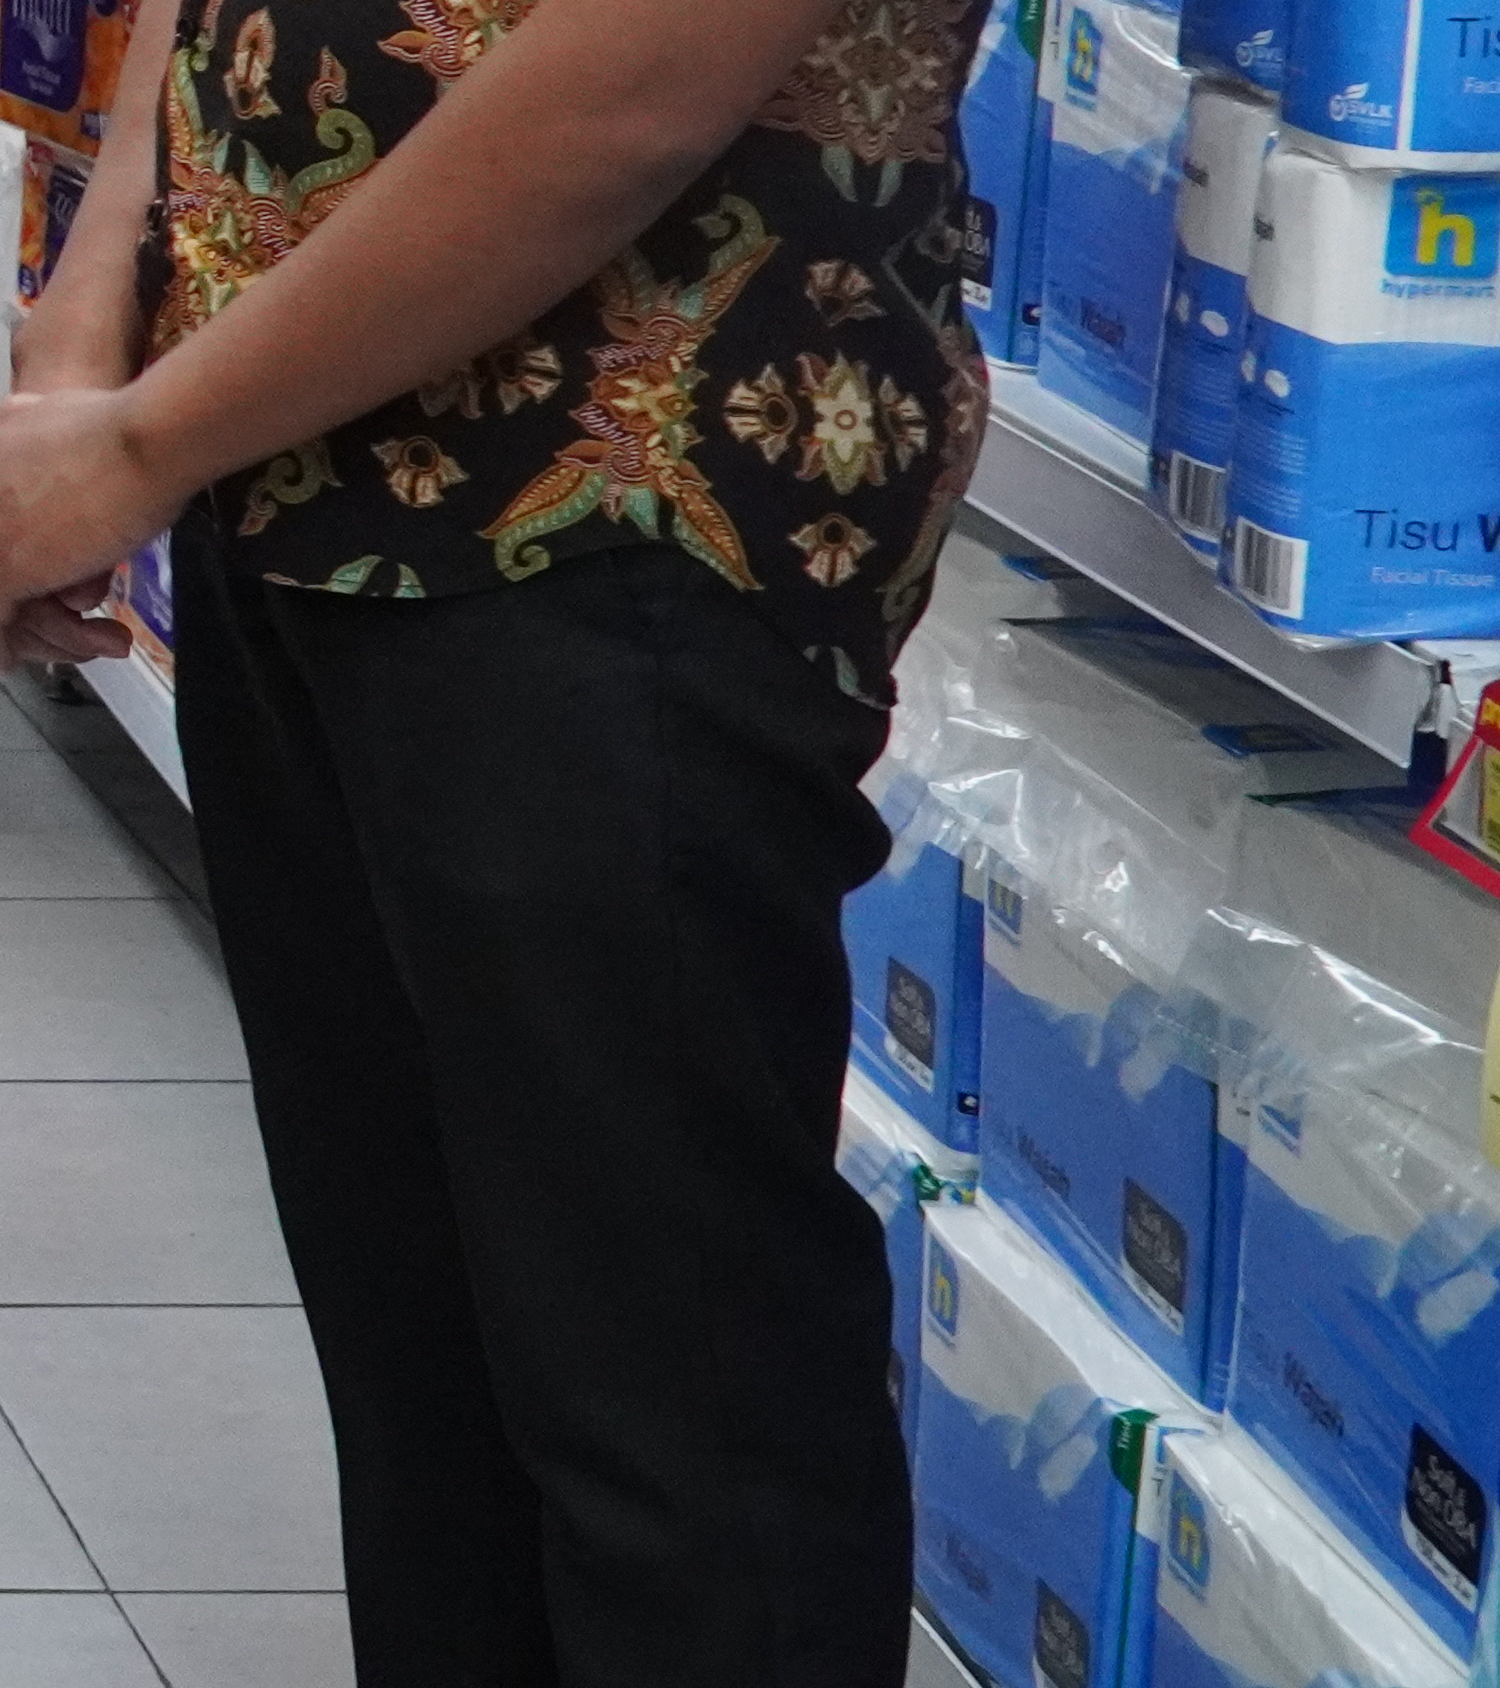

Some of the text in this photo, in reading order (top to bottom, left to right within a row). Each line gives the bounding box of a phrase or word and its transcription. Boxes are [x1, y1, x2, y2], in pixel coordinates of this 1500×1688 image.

[1446, 15, 1500, 60] Tis
[1351, 101, 1394, 120] SVLK
[1416, 200, 1475, 268] h
[1381, 278, 1496, 300] hypermart
[1354, 510, 1460, 552] Tisu
[1372, 566, 1495, 587] Facial Tissue
